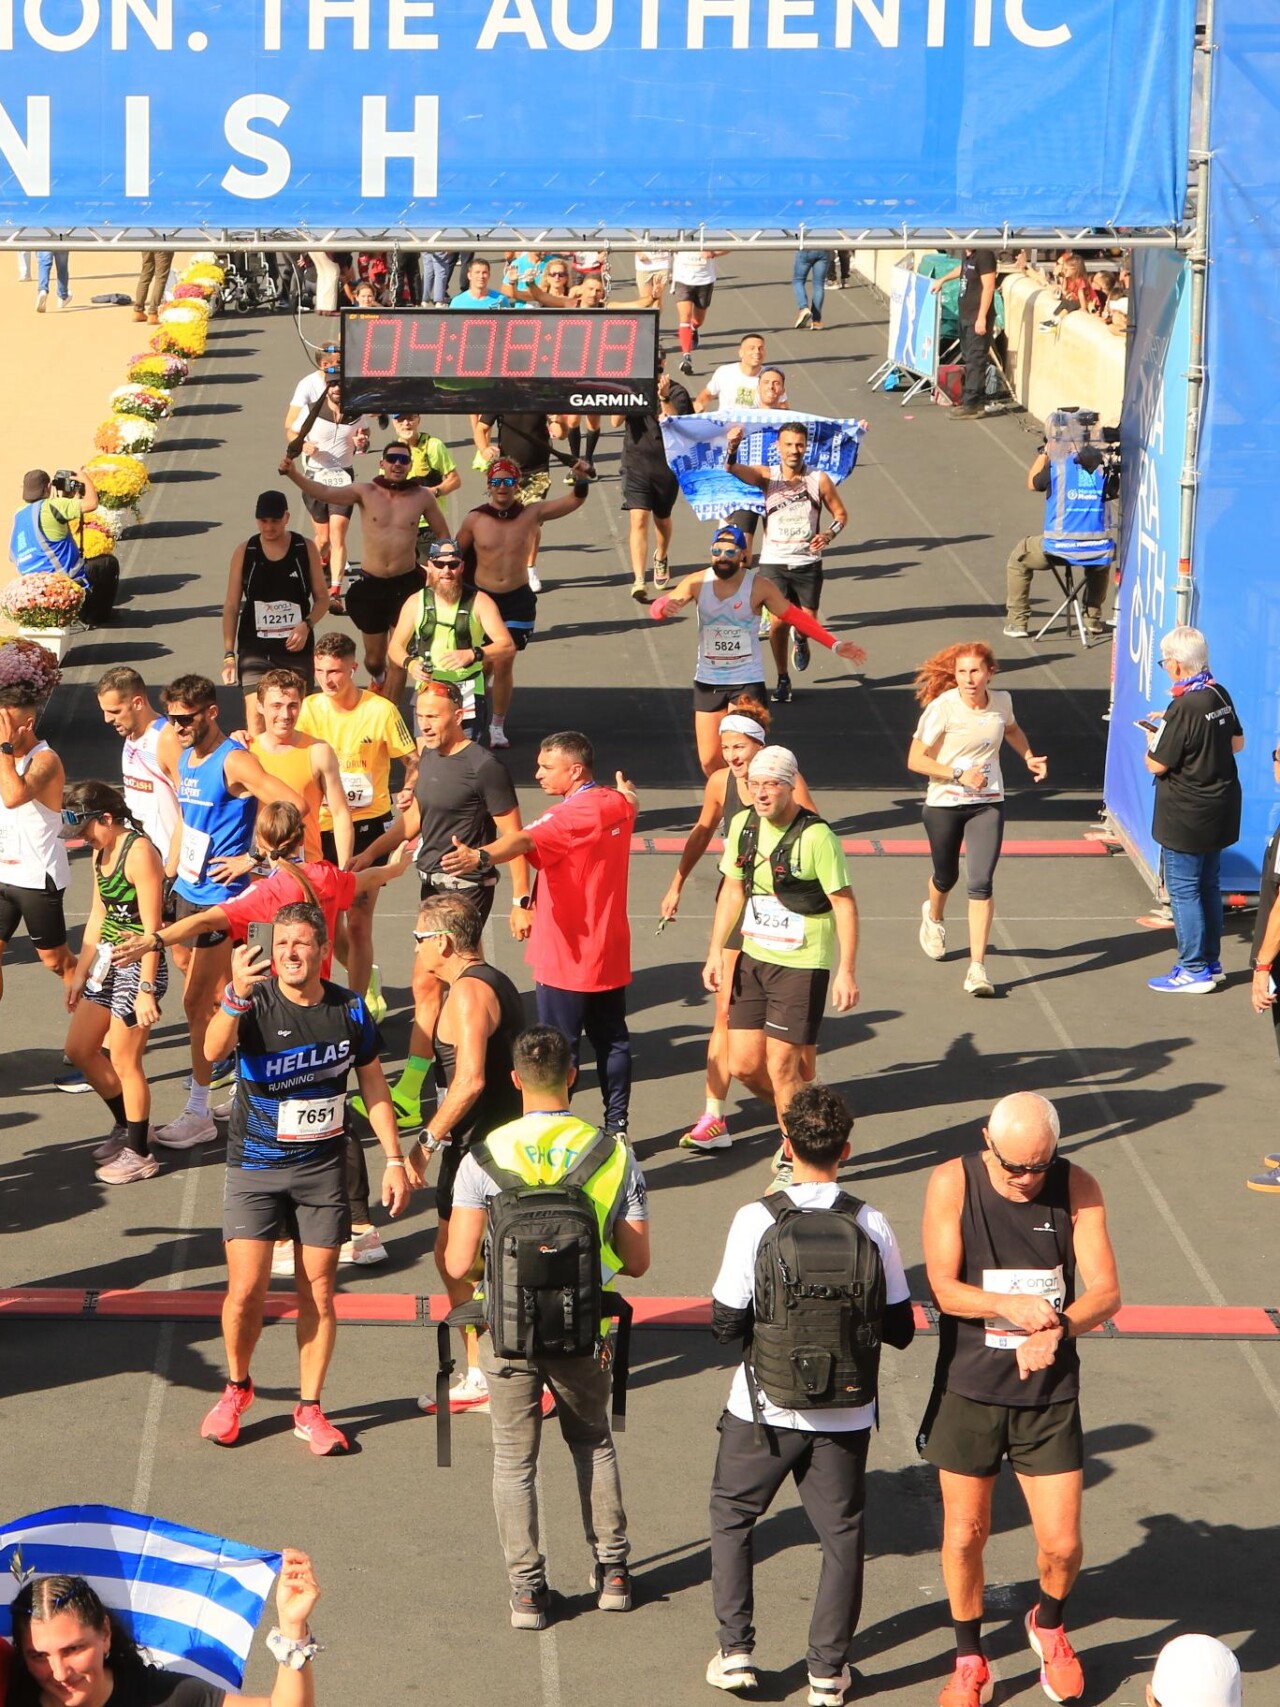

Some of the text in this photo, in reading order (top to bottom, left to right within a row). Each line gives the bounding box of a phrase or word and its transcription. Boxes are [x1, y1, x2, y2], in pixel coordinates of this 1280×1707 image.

[262, 0, 439, 50] THE
[475, 0, 1073, 50] AUTHENTIC
[361, 318, 639, 377] 04:08:08
[262, 613, 295, 625] 12217
[715, 641, 741, 651] 5824
[265, 1040, 351, 1077] HELLAS
[268, 1073, 315, 1092] RUNNING
[296, 1106, 335, 1125] 7651
